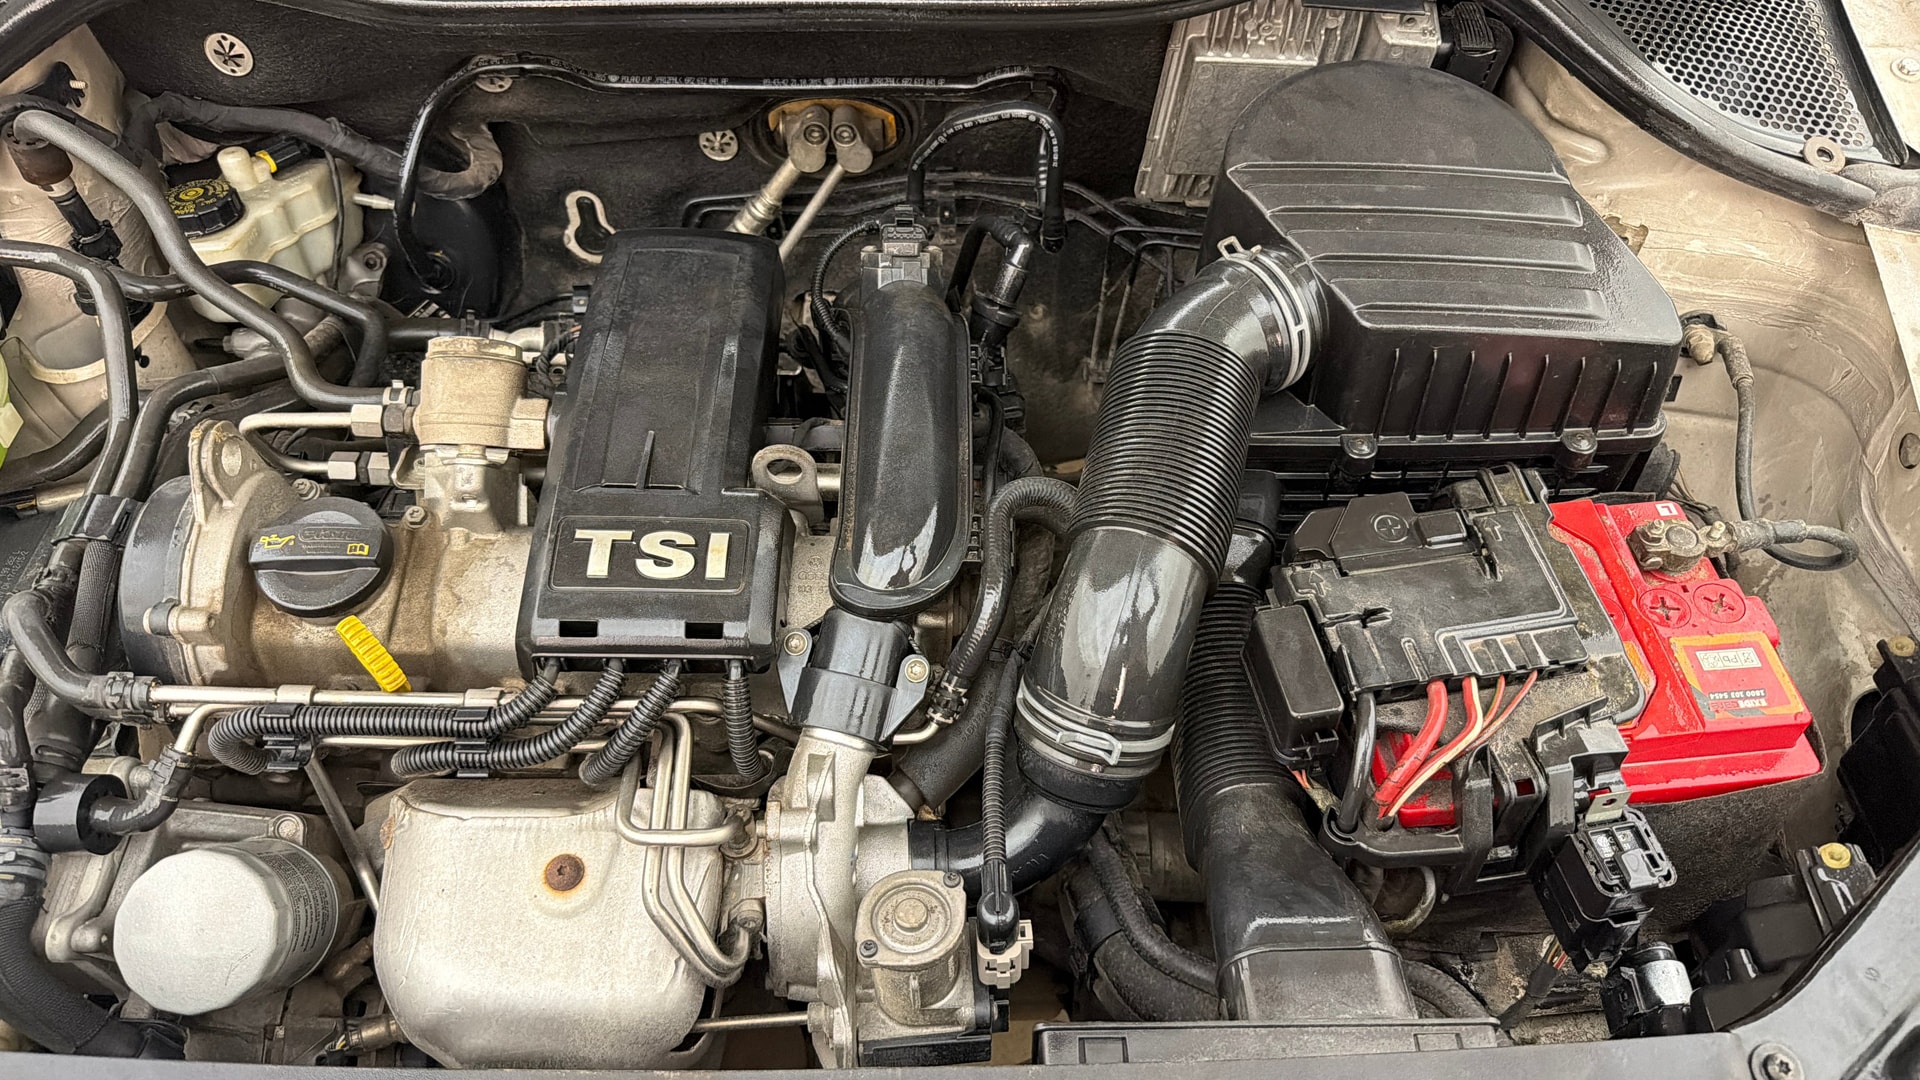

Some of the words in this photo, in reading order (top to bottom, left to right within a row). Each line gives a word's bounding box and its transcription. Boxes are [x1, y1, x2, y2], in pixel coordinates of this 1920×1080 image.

[574, 529, 732, 581] TSI
[1722, 654, 1739, 664] Pb
[1709, 692, 1729, 700] 5454
[1746, 689, 1765, 698] 1800
